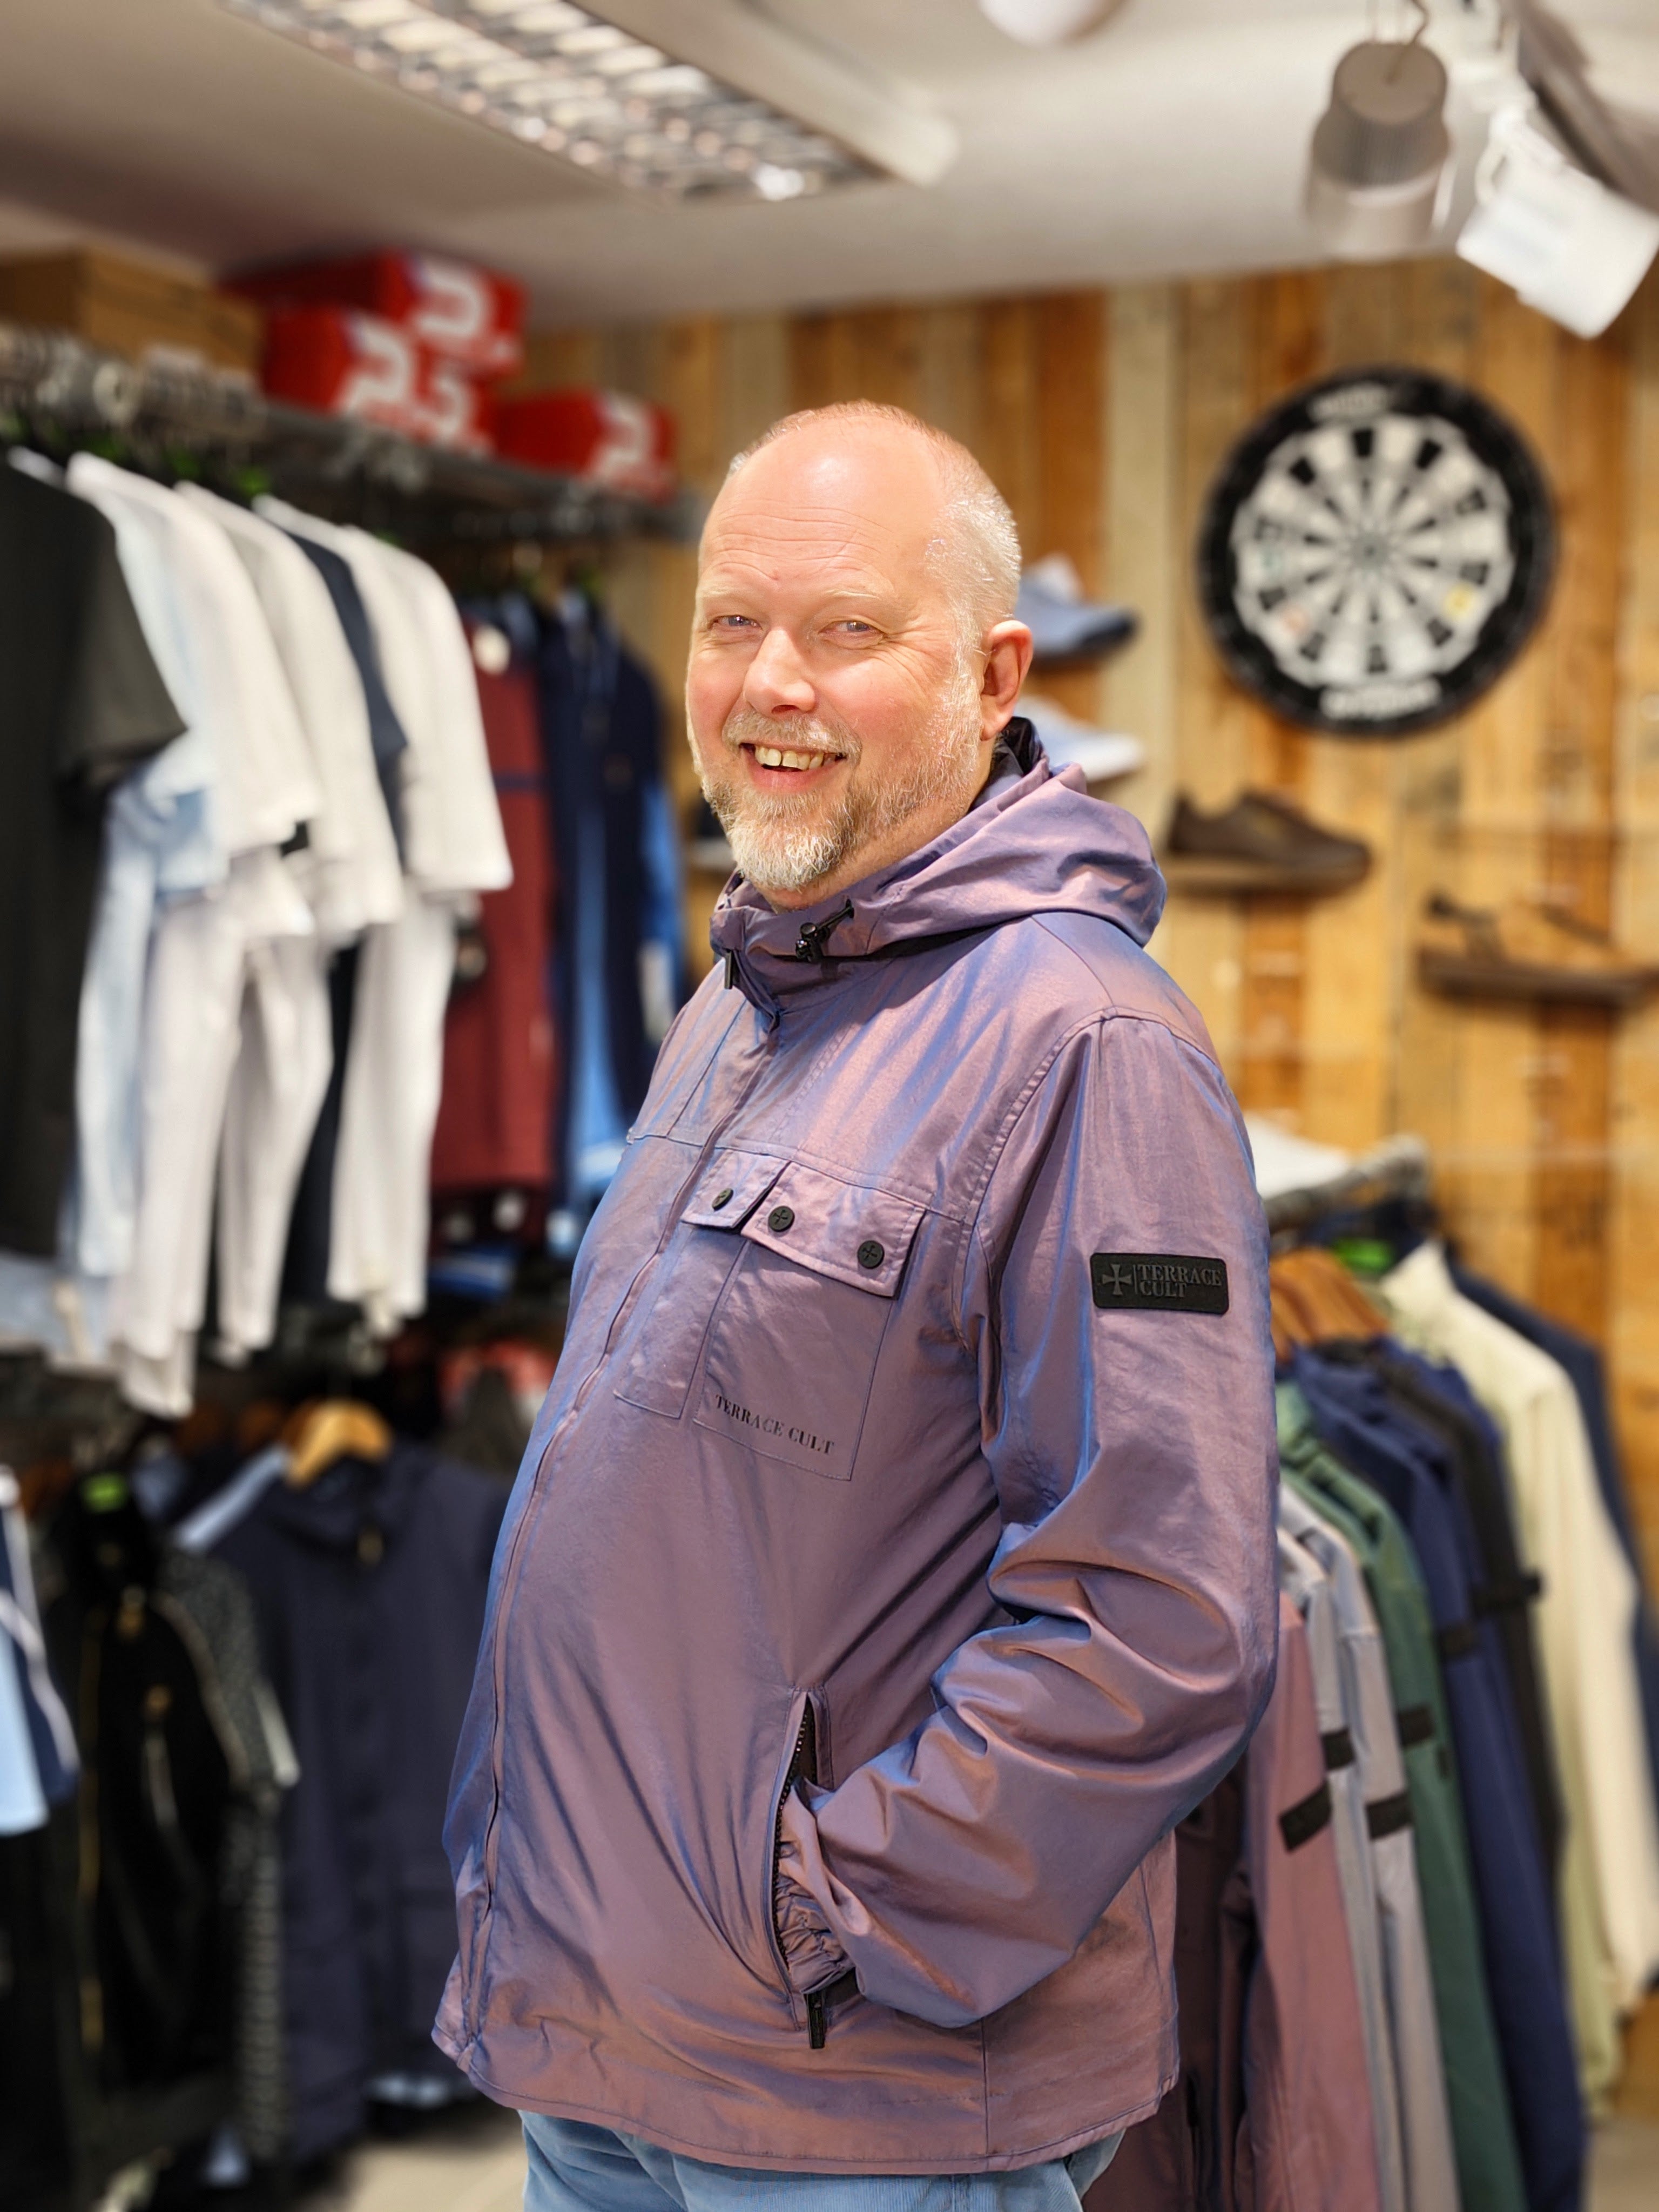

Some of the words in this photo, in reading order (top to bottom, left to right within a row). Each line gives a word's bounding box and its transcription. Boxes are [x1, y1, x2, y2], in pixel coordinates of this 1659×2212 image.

[1137, 1264, 1222, 1286] TERRACE
[1139, 1280, 1188, 1298] CULT
[716, 1394, 785, 1437] TERRACE
[788, 1427, 835, 1454] CULT
